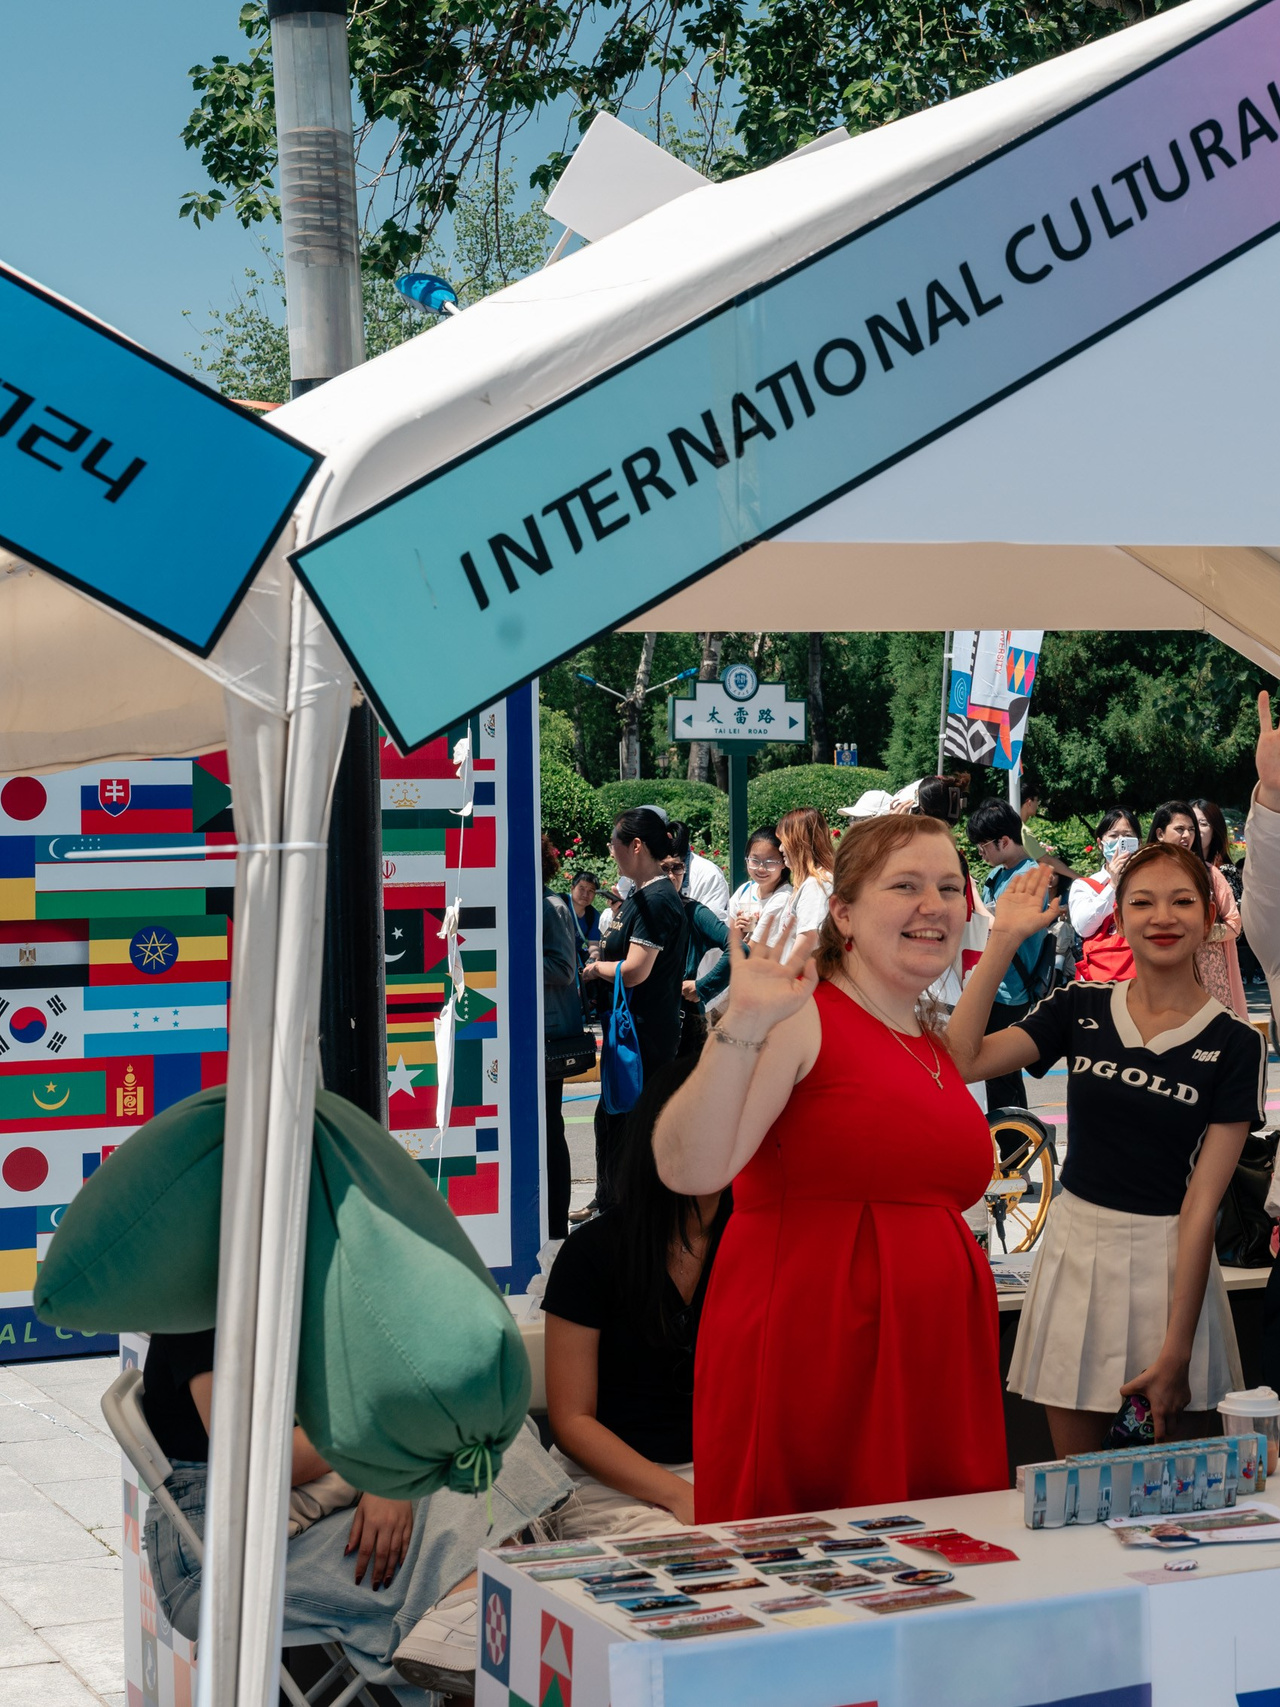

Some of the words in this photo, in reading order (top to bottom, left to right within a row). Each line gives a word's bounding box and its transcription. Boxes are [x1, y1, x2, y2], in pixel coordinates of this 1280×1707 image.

[460, 261, 1002, 610] INTERNATIONAL
[706, 706, 775, 725] 太雷路
[1072, 1056, 1200, 1106] DGOLD
